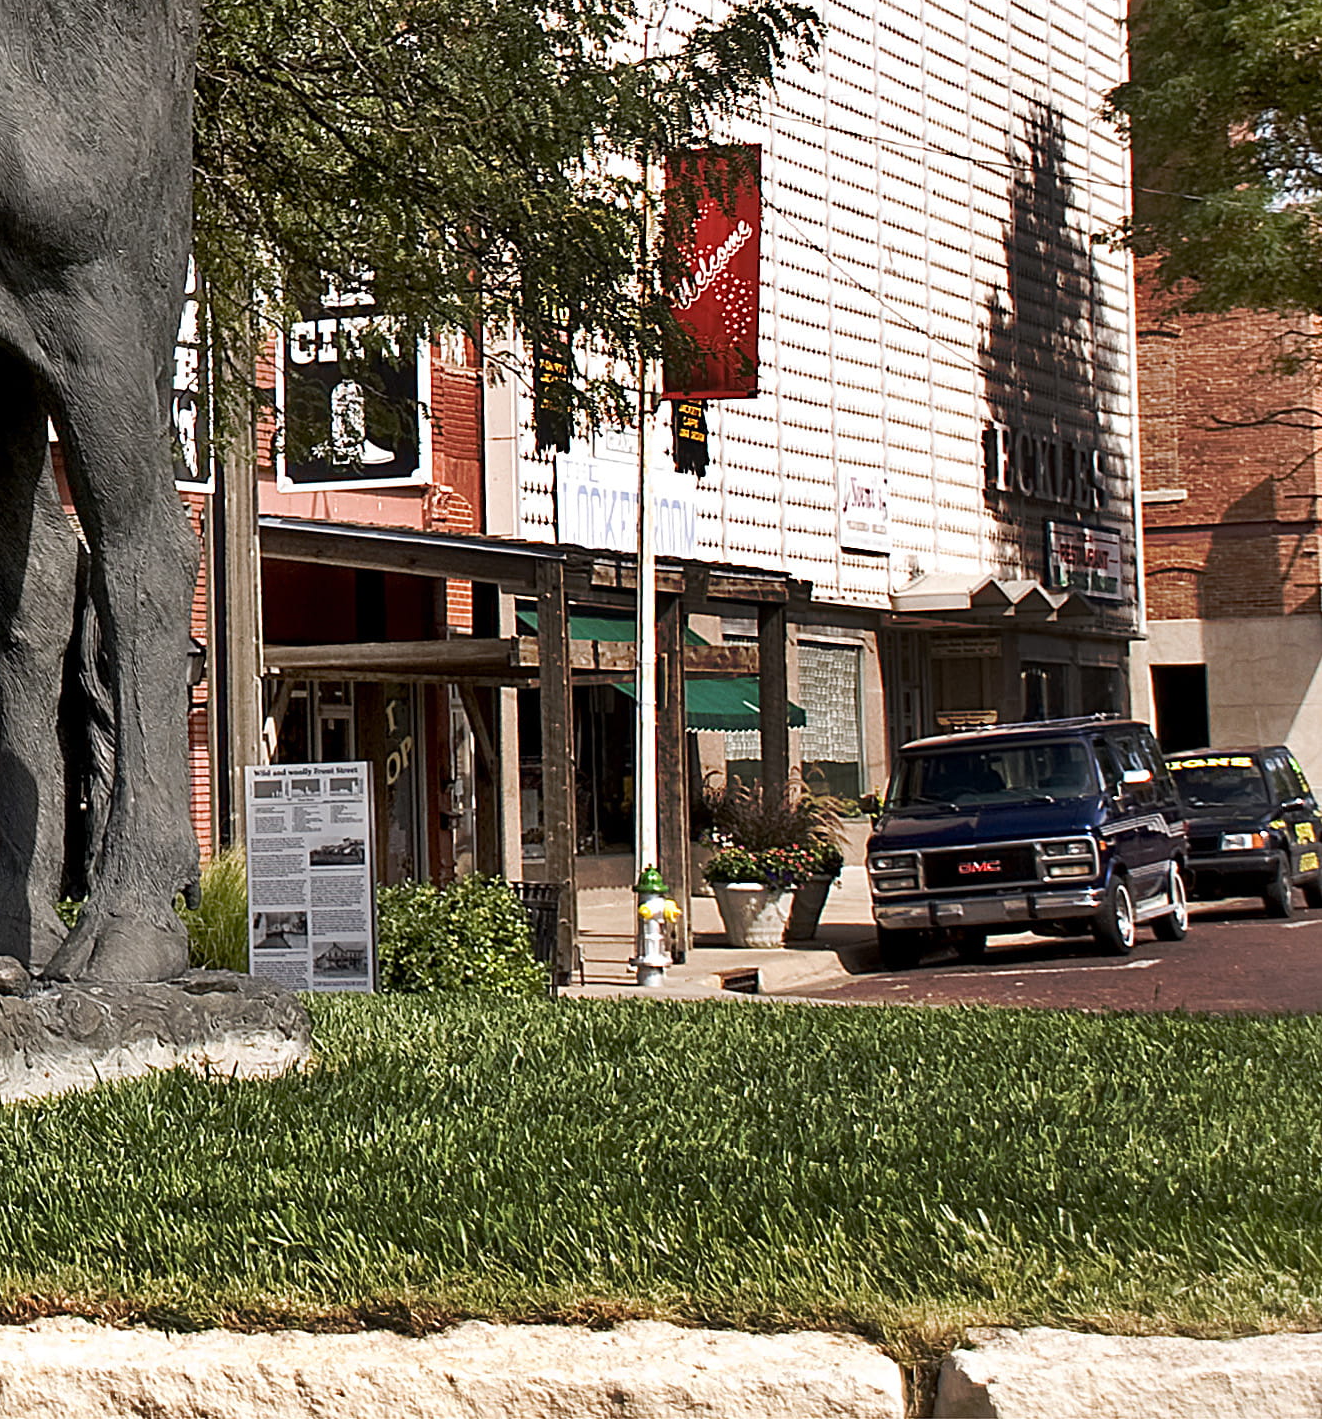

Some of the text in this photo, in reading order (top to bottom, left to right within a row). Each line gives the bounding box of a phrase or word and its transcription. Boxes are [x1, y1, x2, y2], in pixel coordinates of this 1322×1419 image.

[669, 219, 752, 310] Welcome
[273, 768, 287, 777] and
[958, 860, 1001, 874] GMC
